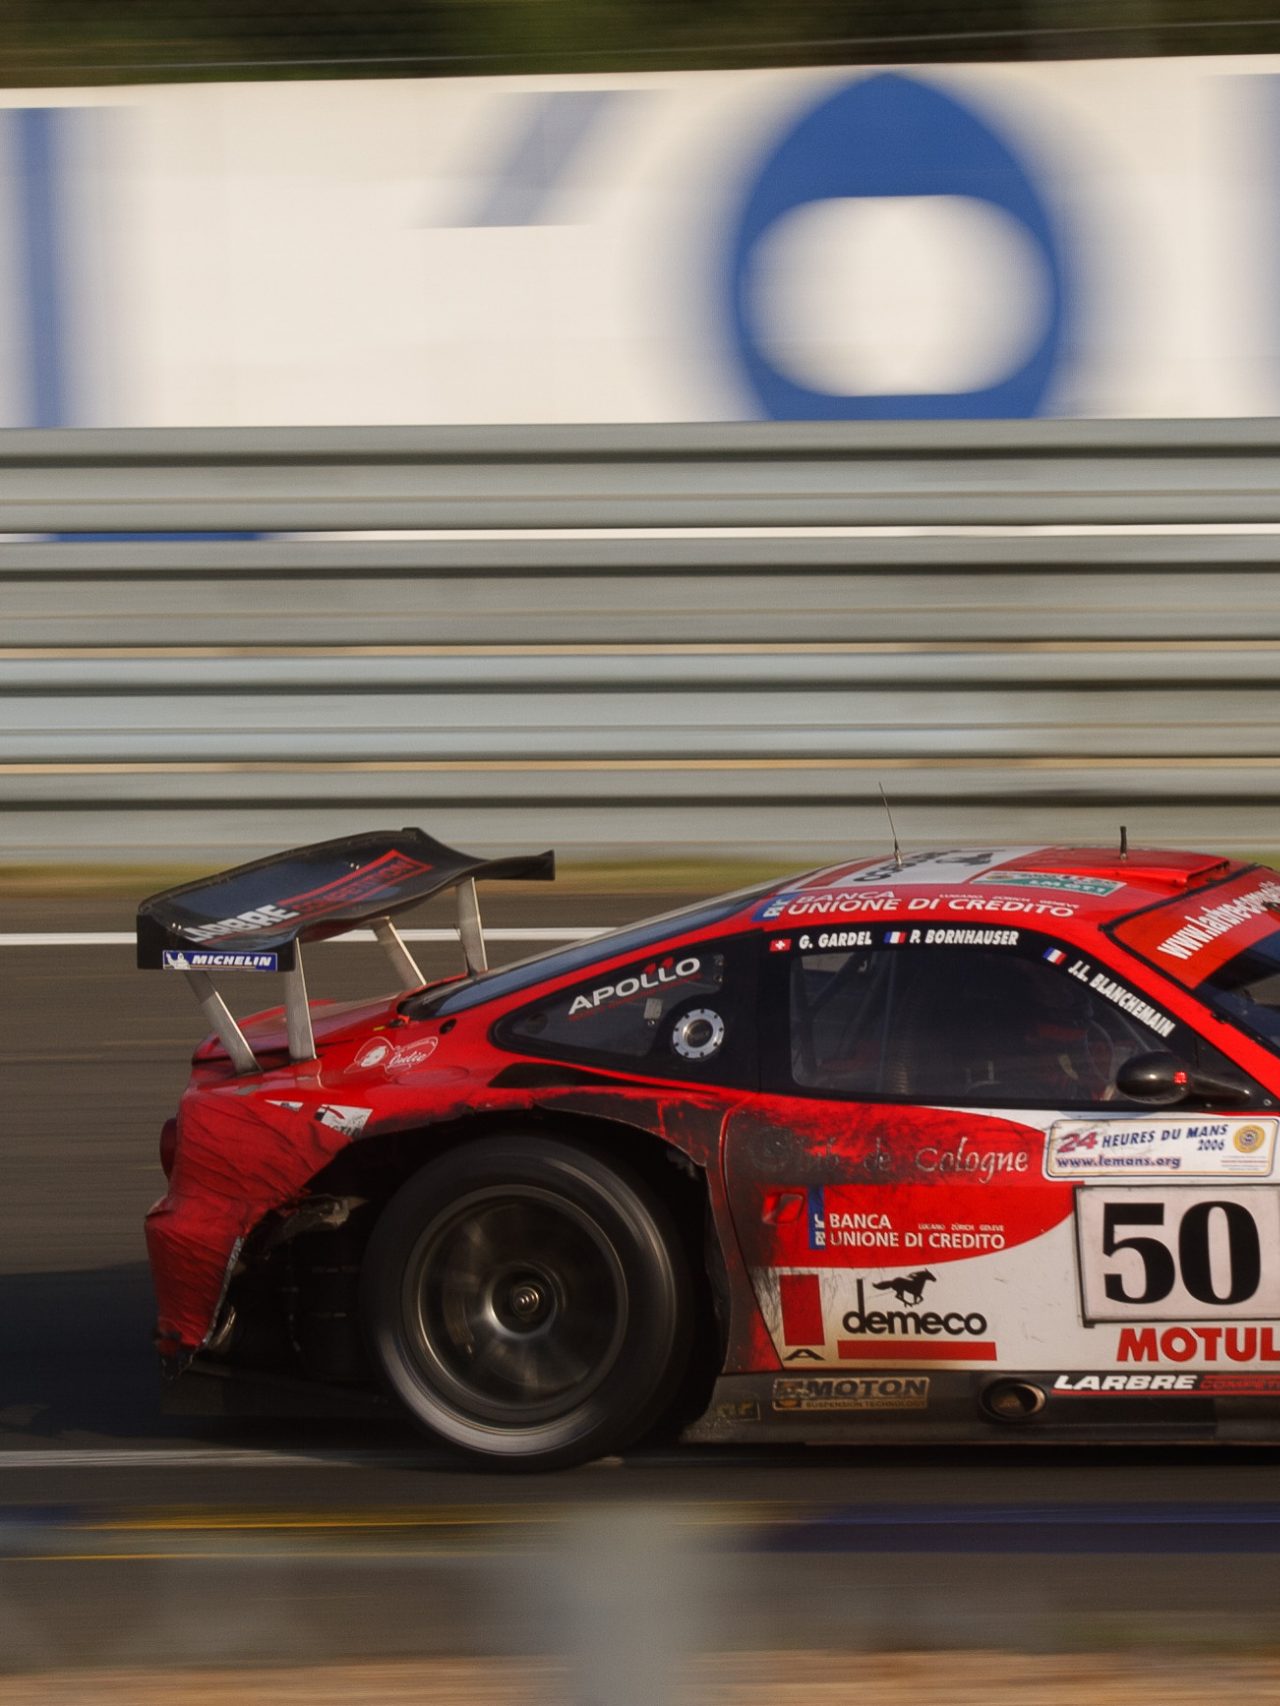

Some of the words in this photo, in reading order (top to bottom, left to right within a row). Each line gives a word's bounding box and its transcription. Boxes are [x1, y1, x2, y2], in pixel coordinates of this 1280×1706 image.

[795, 890, 896, 904] BANCA
[787, 898, 902, 916] UNIONE
[907, 897, 941, 911] DI
[947, 897, 1075, 918] CREDITO
[181, 904, 300, 943] LARBRE
[799, 934, 814, 949] G.
[818, 931, 873, 948] GARDEL
[909, 929, 921, 944] P.
[924, 929, 1020, 946] BORNHAUSER
[191, 954, 273, 967] MICHELIN
[567, 957, 701, 1016] APOLLO
[1067, 959, 1091, 982] J.L.
[1088, 972, 1177, 1038] BLANCHEMAIN
[1056, 1130, 1099, 1153] 24
[1101, 1130, 1156, 1149] HEURES
[1161, 1127, 1182, 1142] DU
[1185, 1123, 1230, 1139] MANS
[1196, 1138, 1226, 1152] 2006
[914, 1135, 1030, 1184] Cologne
[1055, 1154, 1182, 1170] www.lemans.org
[829, 1212, 892, 1230] BANCA
[830, 1231, 900, 1248] UNIONE
[904, 1232, 923, 1248] DI
[928, 1232, 1006, 1249] CREDITO
[1102, 1200, 1262, 1305] 50
[841, 1278, 988, 1335] demeco
[805, 1378, 927, 1397] MOTON
[1053, 1374, 1198, 1391] LARBRE
